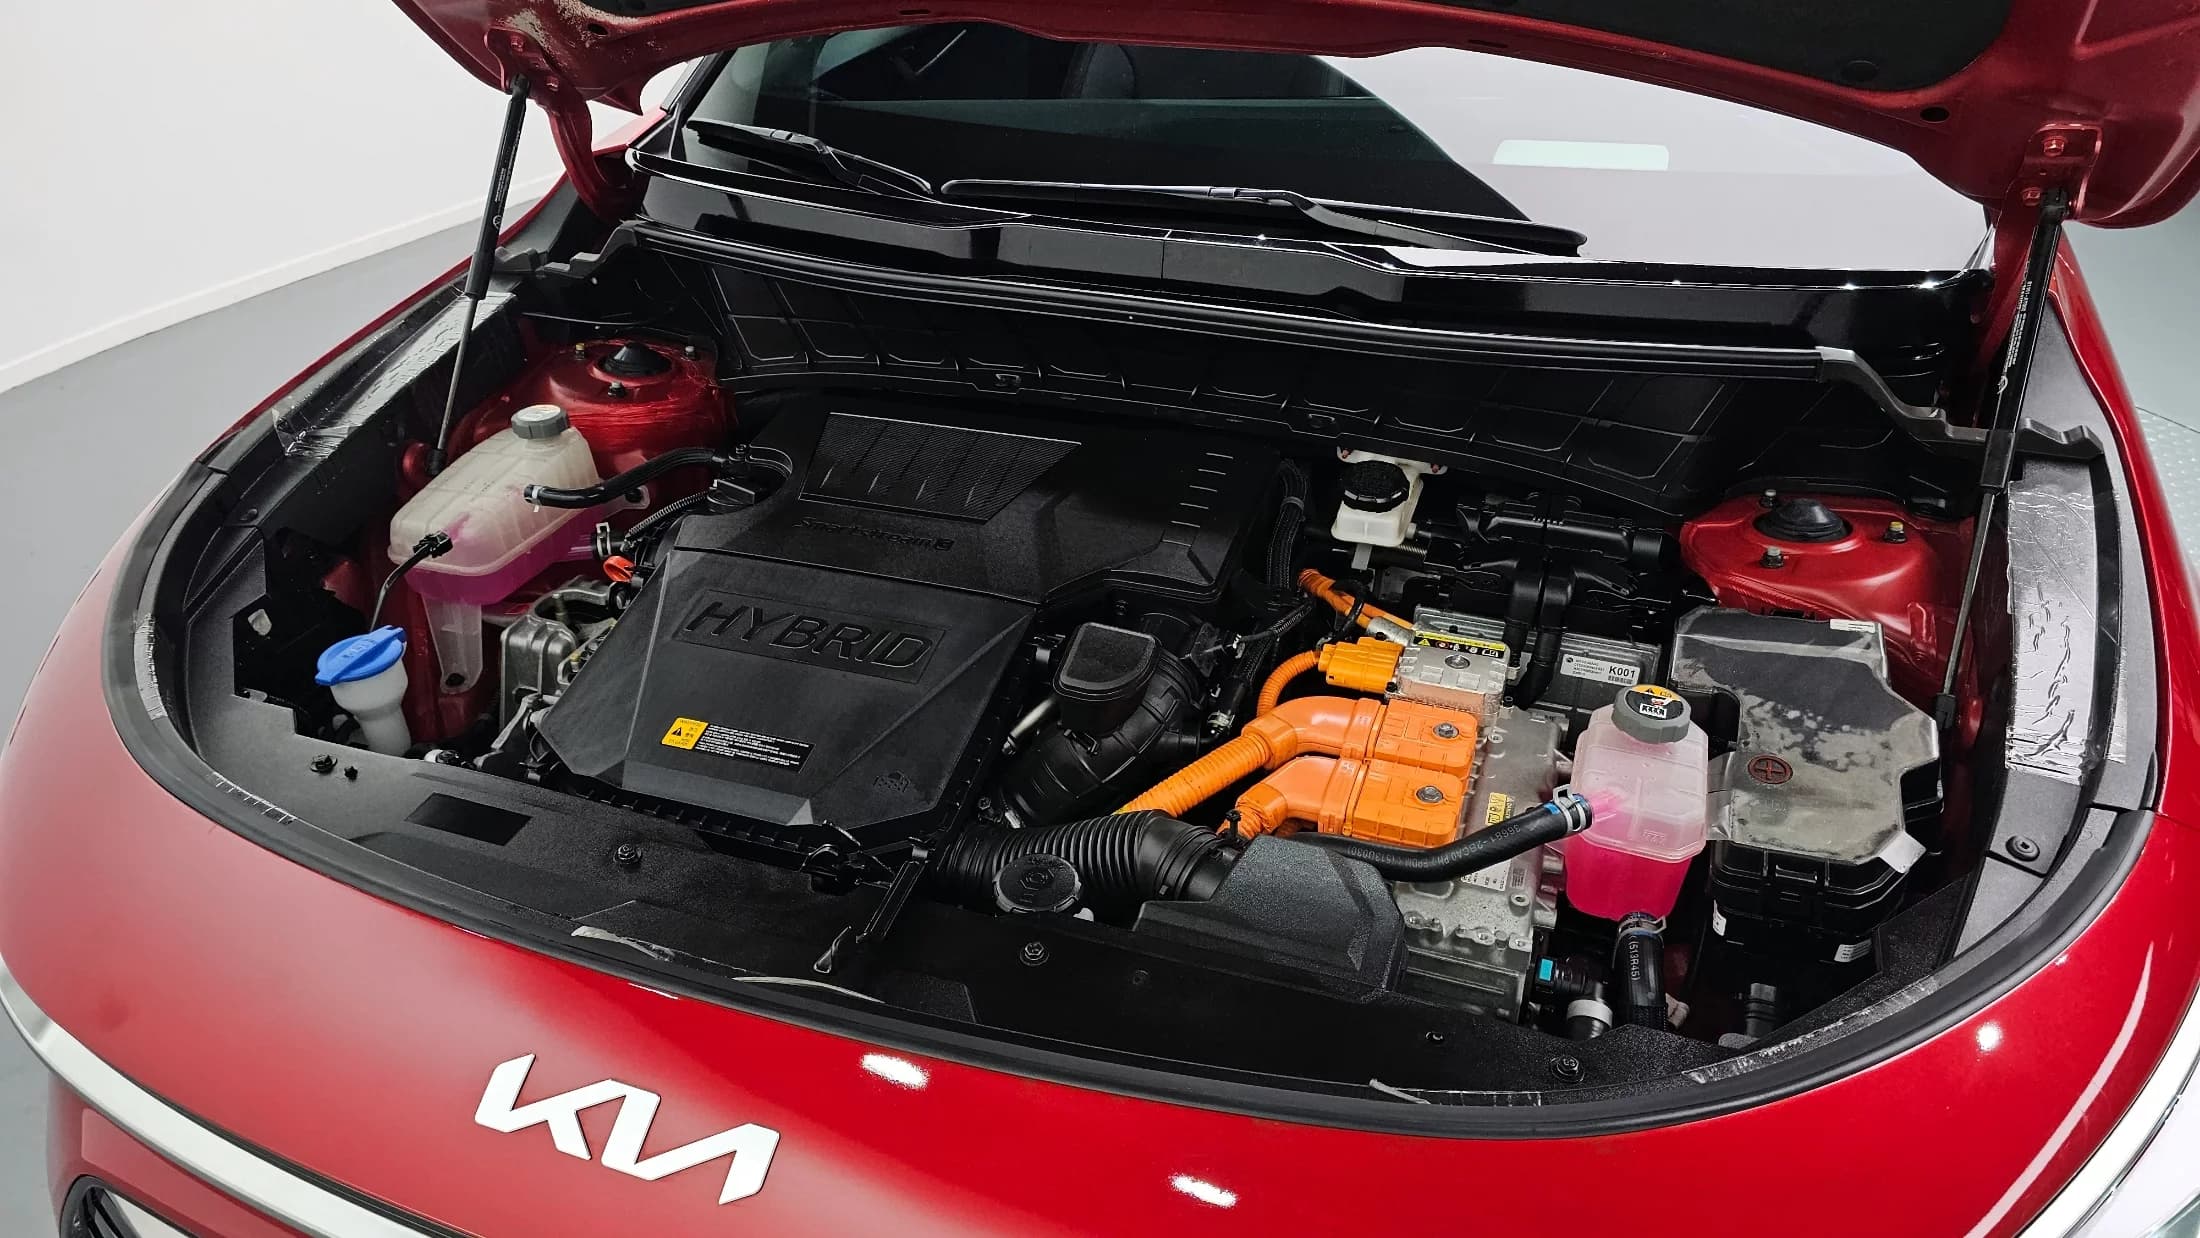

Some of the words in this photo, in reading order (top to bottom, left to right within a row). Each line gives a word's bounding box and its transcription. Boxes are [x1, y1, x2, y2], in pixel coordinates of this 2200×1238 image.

[684, 601, 933, 668] HYBRID
[1608, 665, 1637, 679] K001
[474, 1053, 781, 1206] KIA
